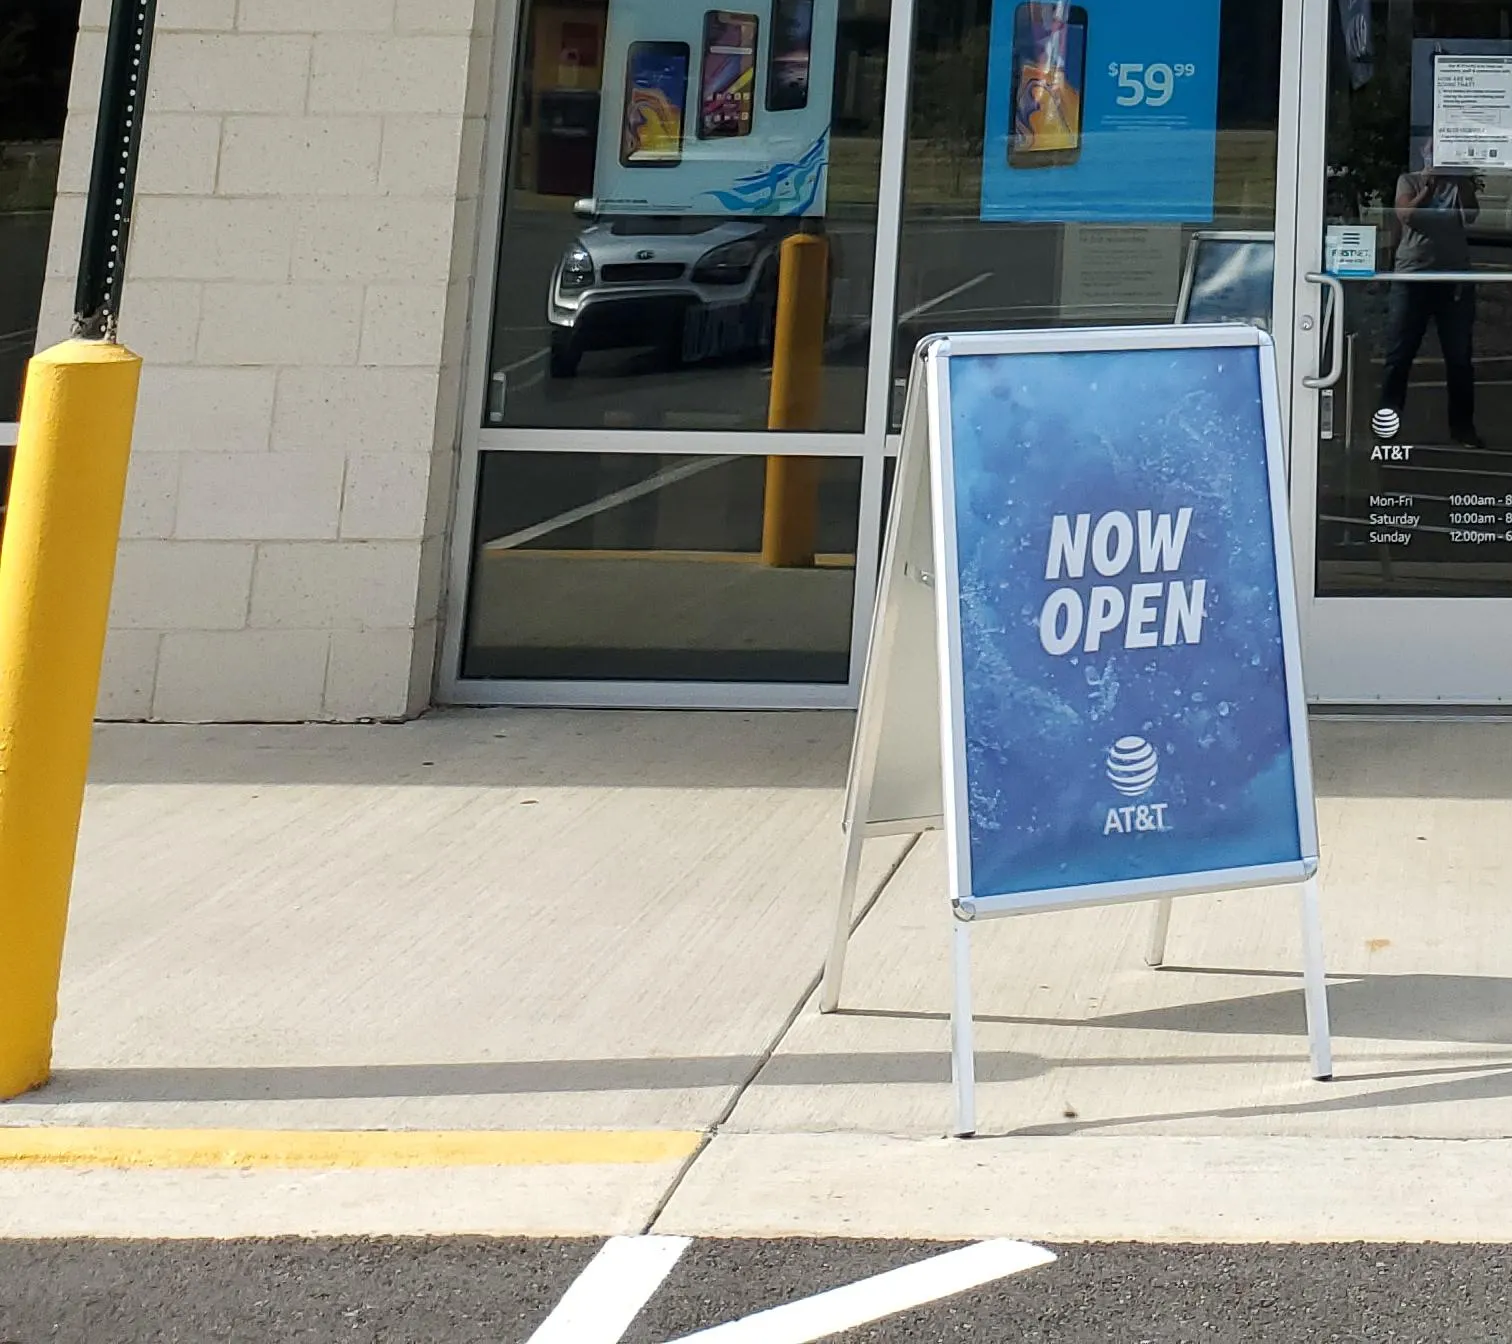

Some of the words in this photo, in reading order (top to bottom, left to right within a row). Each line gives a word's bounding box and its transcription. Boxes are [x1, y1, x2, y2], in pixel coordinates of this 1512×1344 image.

[1371, 445, 1413, 461] AT&T
[1369, 495, 1413, 507] Mon-Fri
[1449, 495, 1495, 506] 10:00am
[1369, 513, 1420, 527] Saturday
[1449, 513, 1495, 524] 10:00am
[1045, 508, 1192, 581] NOW
[1369, 530, 1412, 545] Sunday
[1450, 530, 1496, 544] 12:00pm
[1039, 579, 1207, 656] OPEN
[1103, 803, 1169, 836] AT&T
